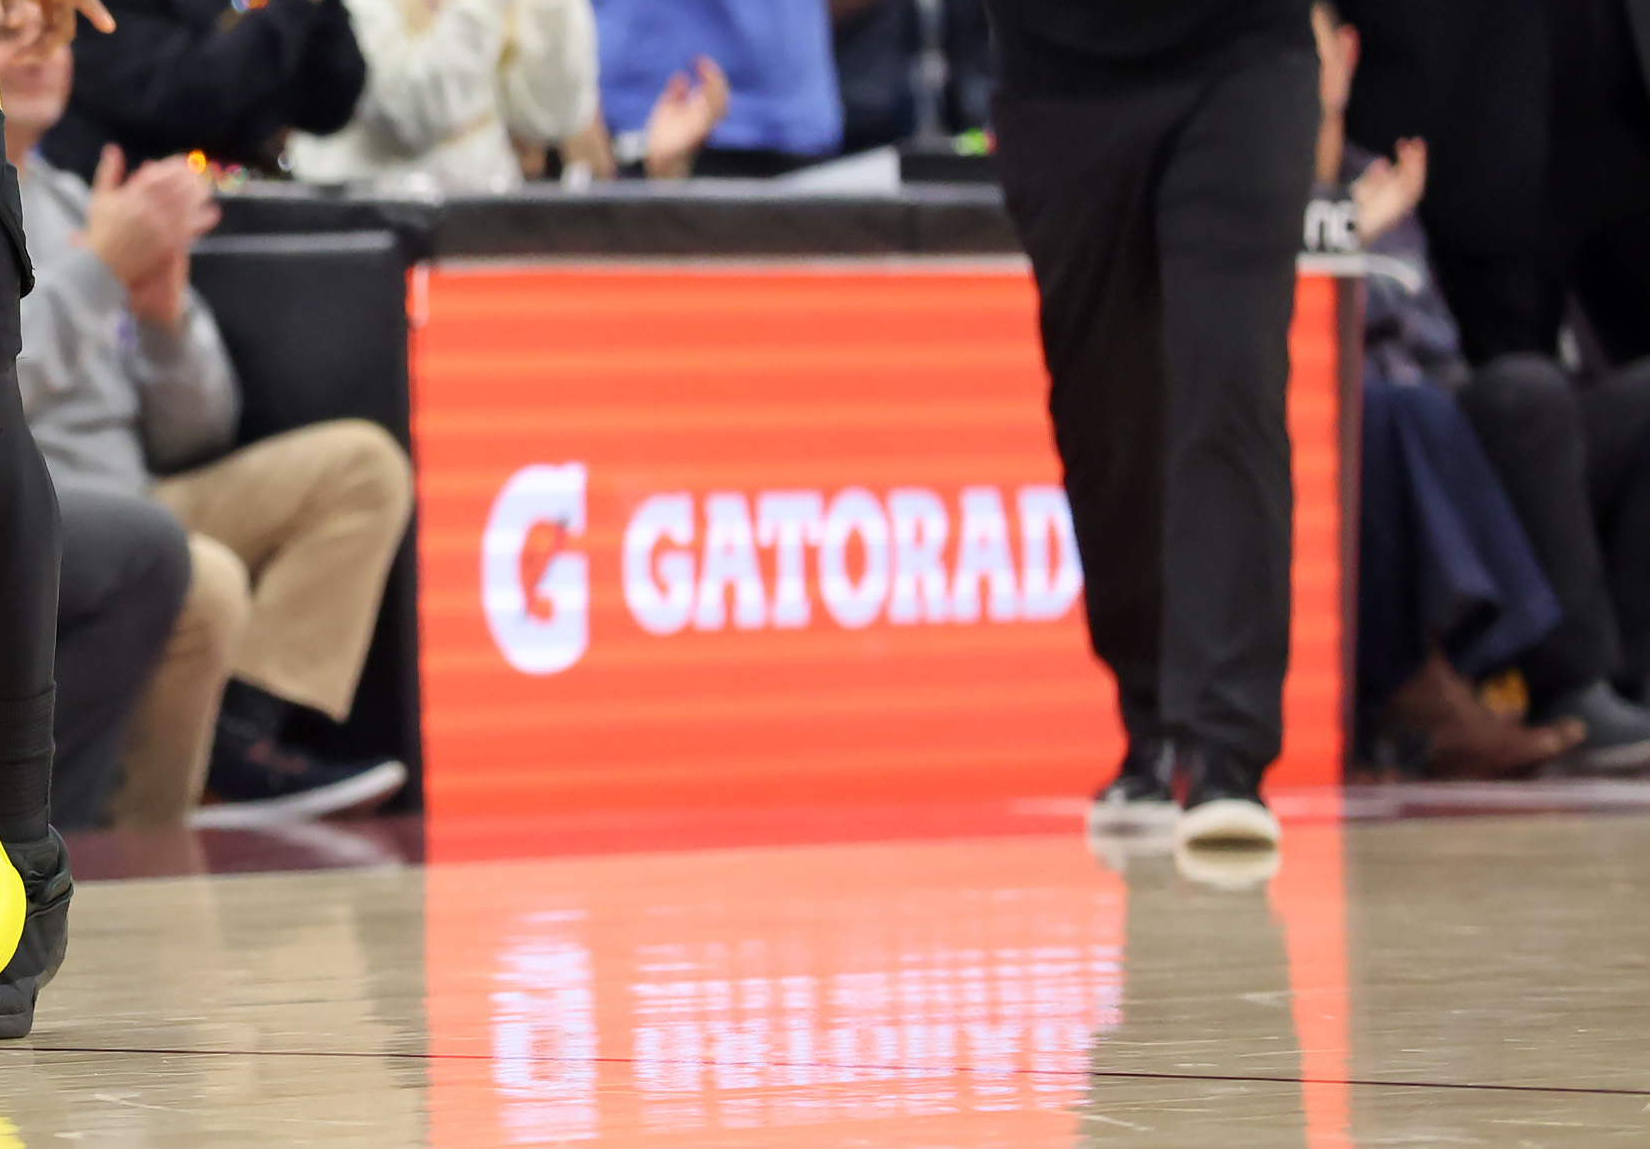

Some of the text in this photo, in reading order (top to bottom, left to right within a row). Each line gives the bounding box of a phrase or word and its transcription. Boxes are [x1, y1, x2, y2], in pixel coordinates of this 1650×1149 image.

[1302, 198, 1361, 251] nc
[481, 461, 1085, 676] G GATORAD
